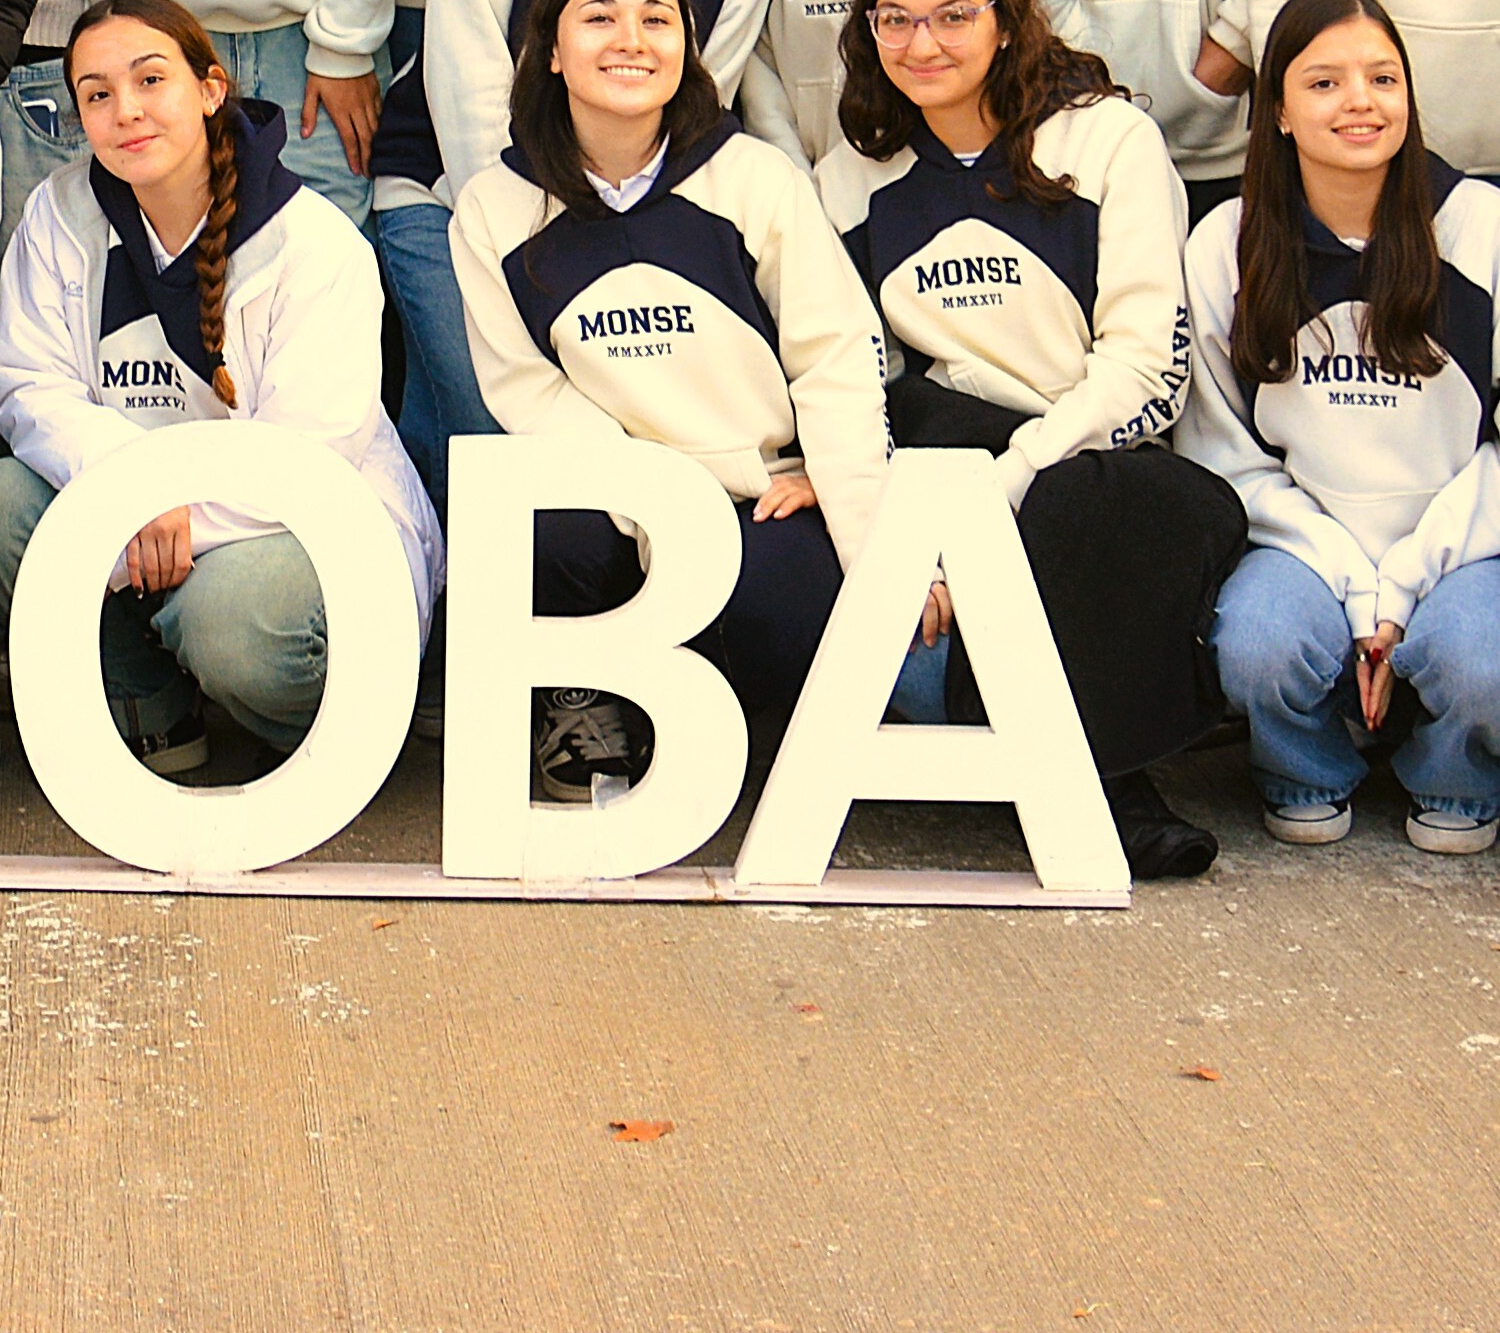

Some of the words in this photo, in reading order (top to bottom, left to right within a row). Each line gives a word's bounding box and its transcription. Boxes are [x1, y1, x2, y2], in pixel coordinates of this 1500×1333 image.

[805, 1, 852, 16] MMXX
[915, 256, 1021, 294] MONSE
[942, 293, 1003, 309] MMXXVI
[577, 305, 695, 342] MONSE
[607, 343, 673, 358] MMXXVI
[1328, 391, 1398, 408] MMXXVI
